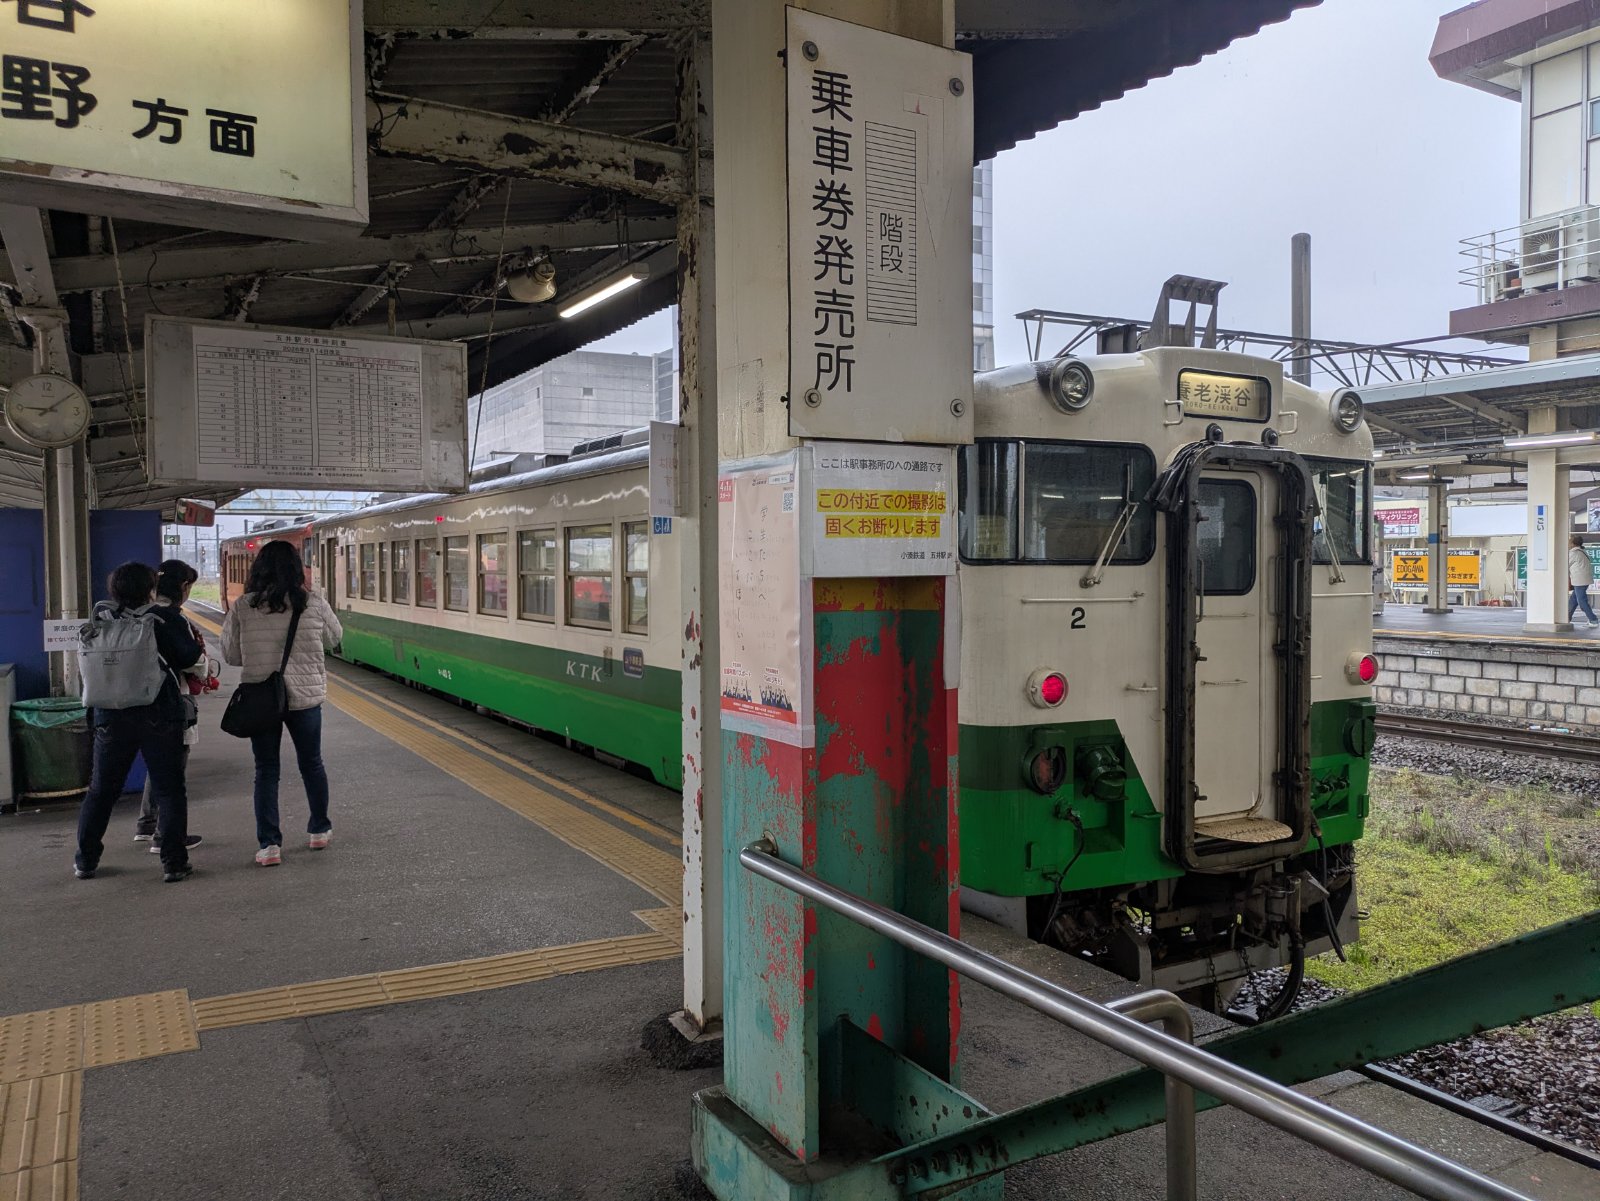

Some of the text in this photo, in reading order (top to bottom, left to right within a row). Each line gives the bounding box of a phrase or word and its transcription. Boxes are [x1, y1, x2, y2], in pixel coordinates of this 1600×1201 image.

[132, 98, 258, 157] 方面
[811, 69, 855, 393] 乗車券発売所
[880, 212, 904, 274] 階段
[42, 382, 52, 391] 12
[73, 406, 80, 416] 3
[821, 458, 943, 473] ここは駅事務所のへの通路です
[819, 492, 946, 511] この付近での撮影は
[826, 518, 940, 536] 固くお断りします
[901, 551, 925, 560] 小湊鉄道
[1396, 565, 1424, 573] EDOGAWA
[1070, 607, 1086, 629] 2
[566, 660, 602, 682] KTK
